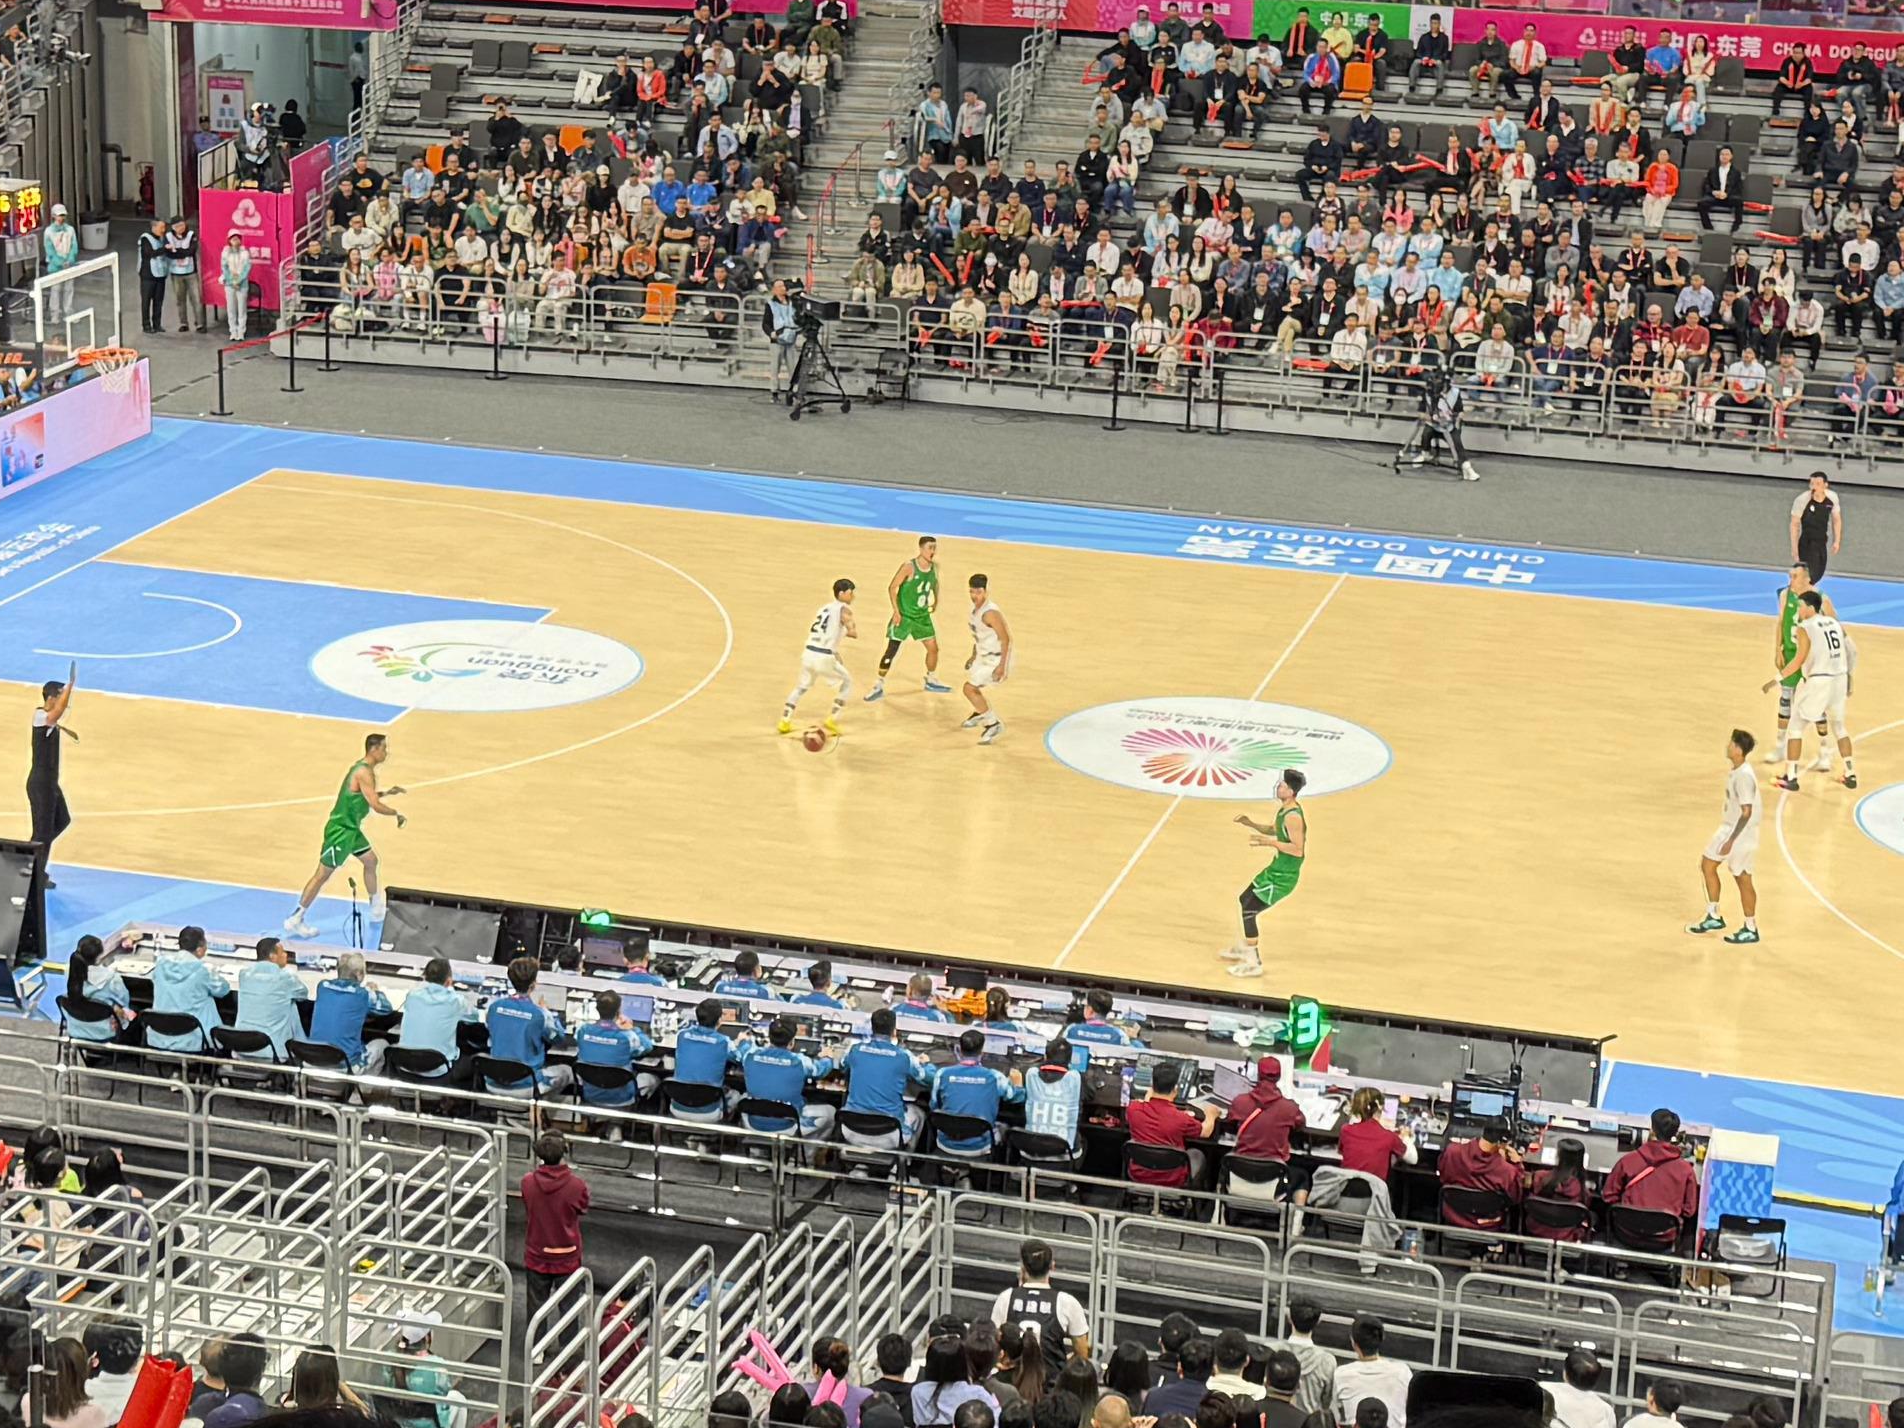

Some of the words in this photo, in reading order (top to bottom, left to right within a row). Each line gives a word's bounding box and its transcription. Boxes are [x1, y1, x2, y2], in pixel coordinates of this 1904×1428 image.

[1427, 545, 1545, 565] CHINA
[810, 614, 829, 633] 24
[1824, 629, 1841, 651] 16
